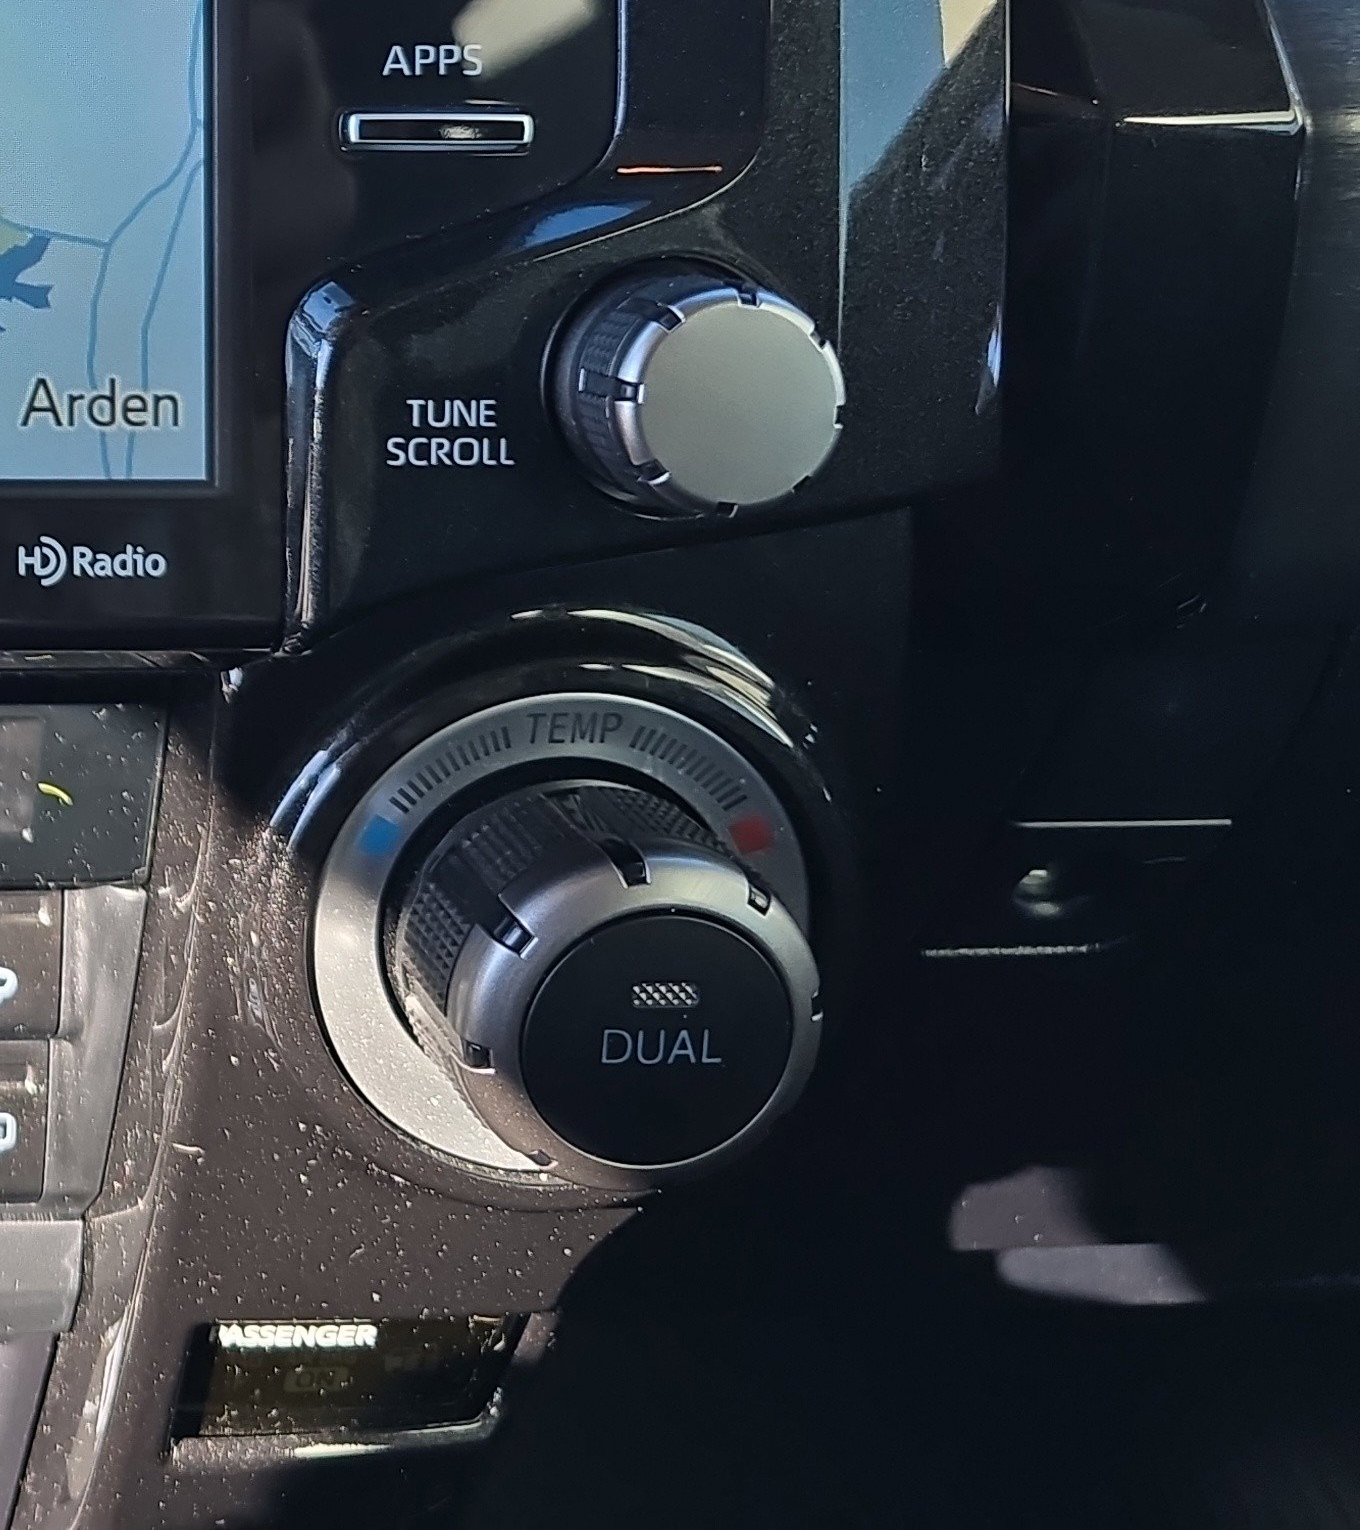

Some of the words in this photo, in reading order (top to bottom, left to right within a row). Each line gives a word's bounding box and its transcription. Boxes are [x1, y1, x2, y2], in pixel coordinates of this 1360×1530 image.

[382, 44, 483, 76] APPS
[20, 377, 182, 429] Arden
[405, 398, 498, 428] TUNE
[385, 437, 516, 467] SCROLL
[73, 544, 168, 579] Radio
[525, 711, 624, 745] TEMP
[600, 1029, 722, 1066] DUAL
